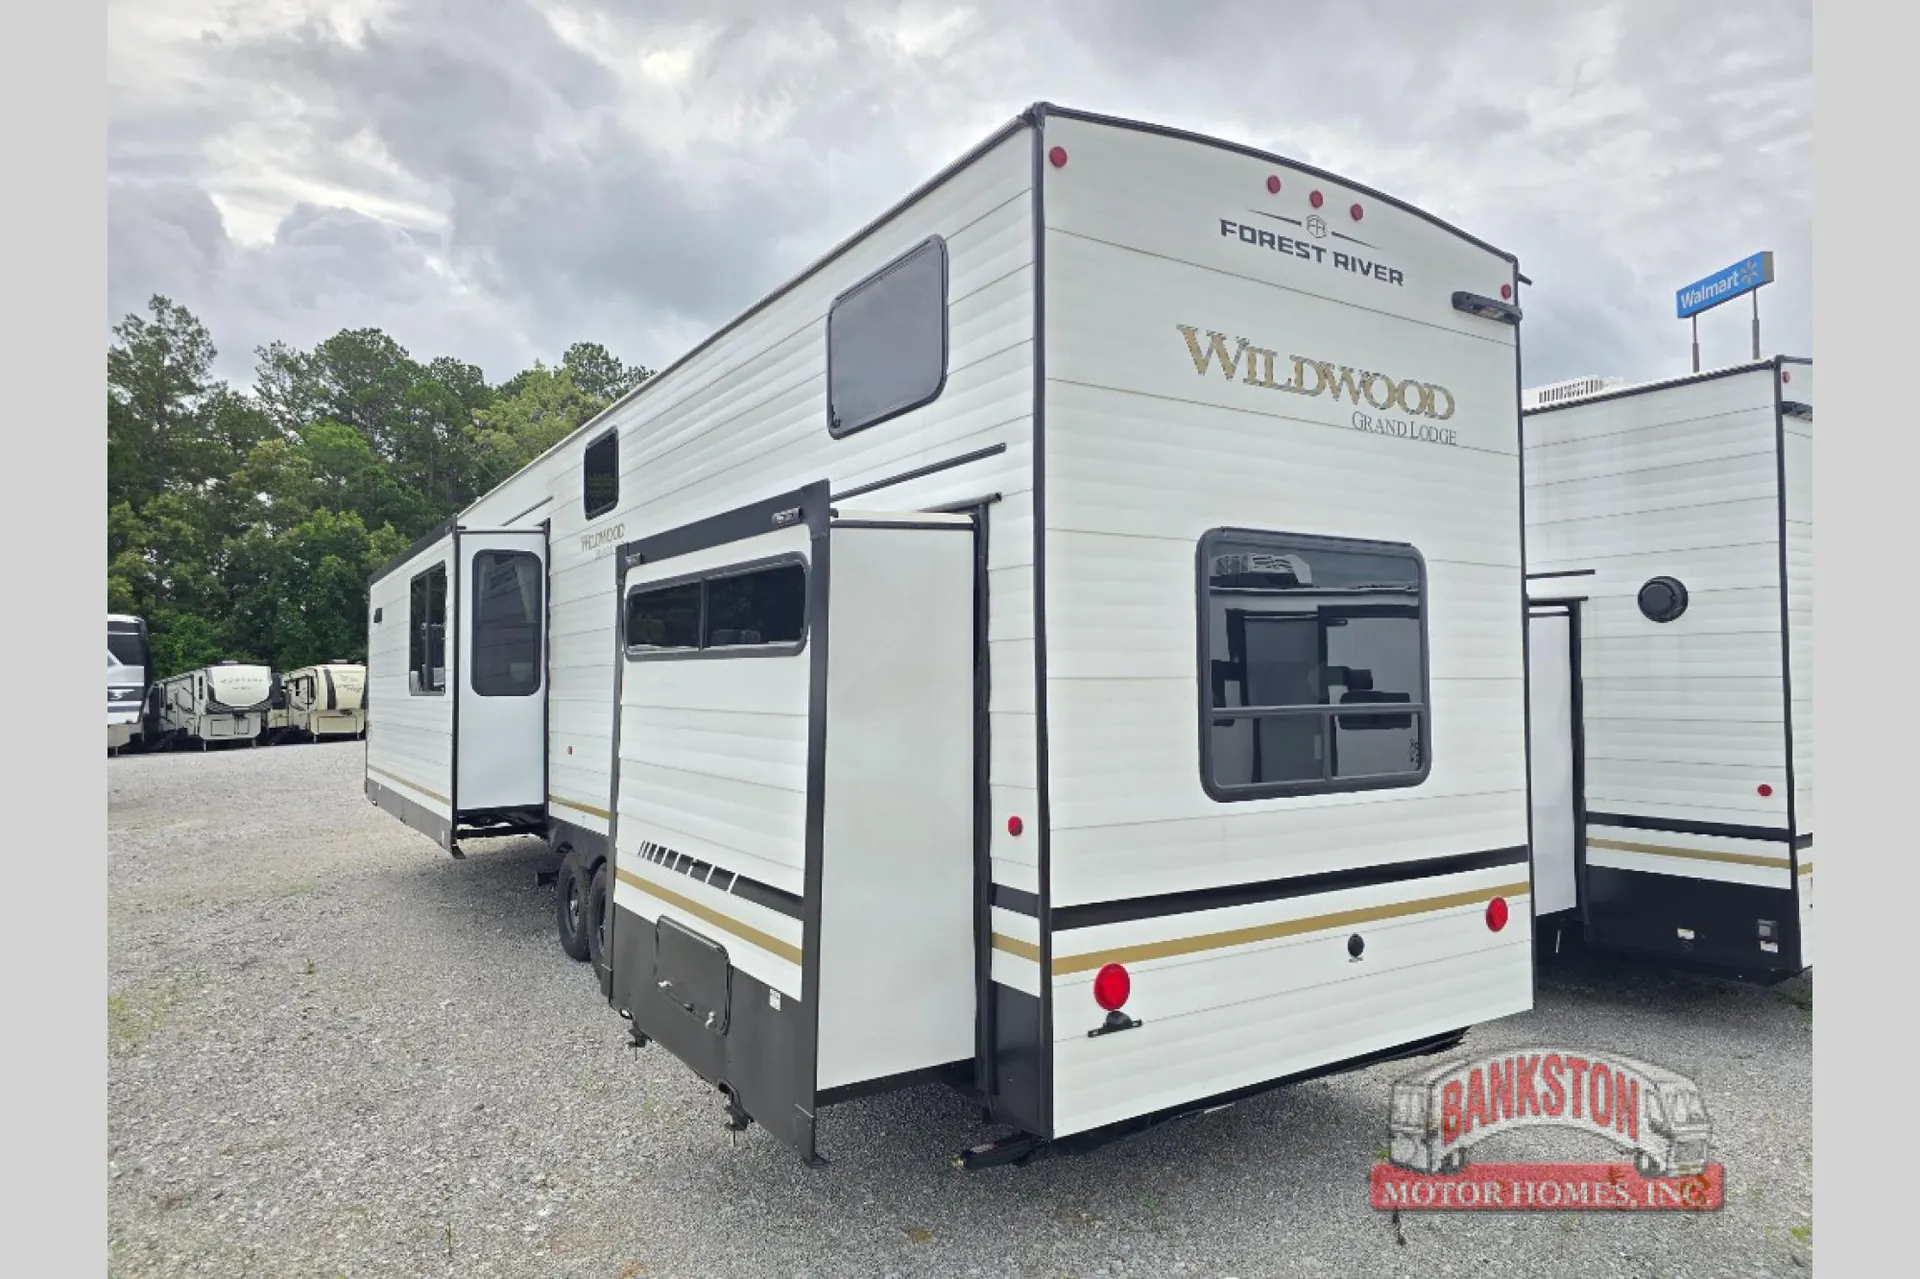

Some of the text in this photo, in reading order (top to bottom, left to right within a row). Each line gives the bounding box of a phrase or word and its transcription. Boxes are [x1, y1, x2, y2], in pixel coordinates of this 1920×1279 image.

[1219, 217, 1404, 287] FOREST RIVER
[1680, 271, 1740, 309] Walmart
[1176, 323, 1456, 420] WILDWOOD
[1352, 411, 1457, 446] GRAND LODGE
